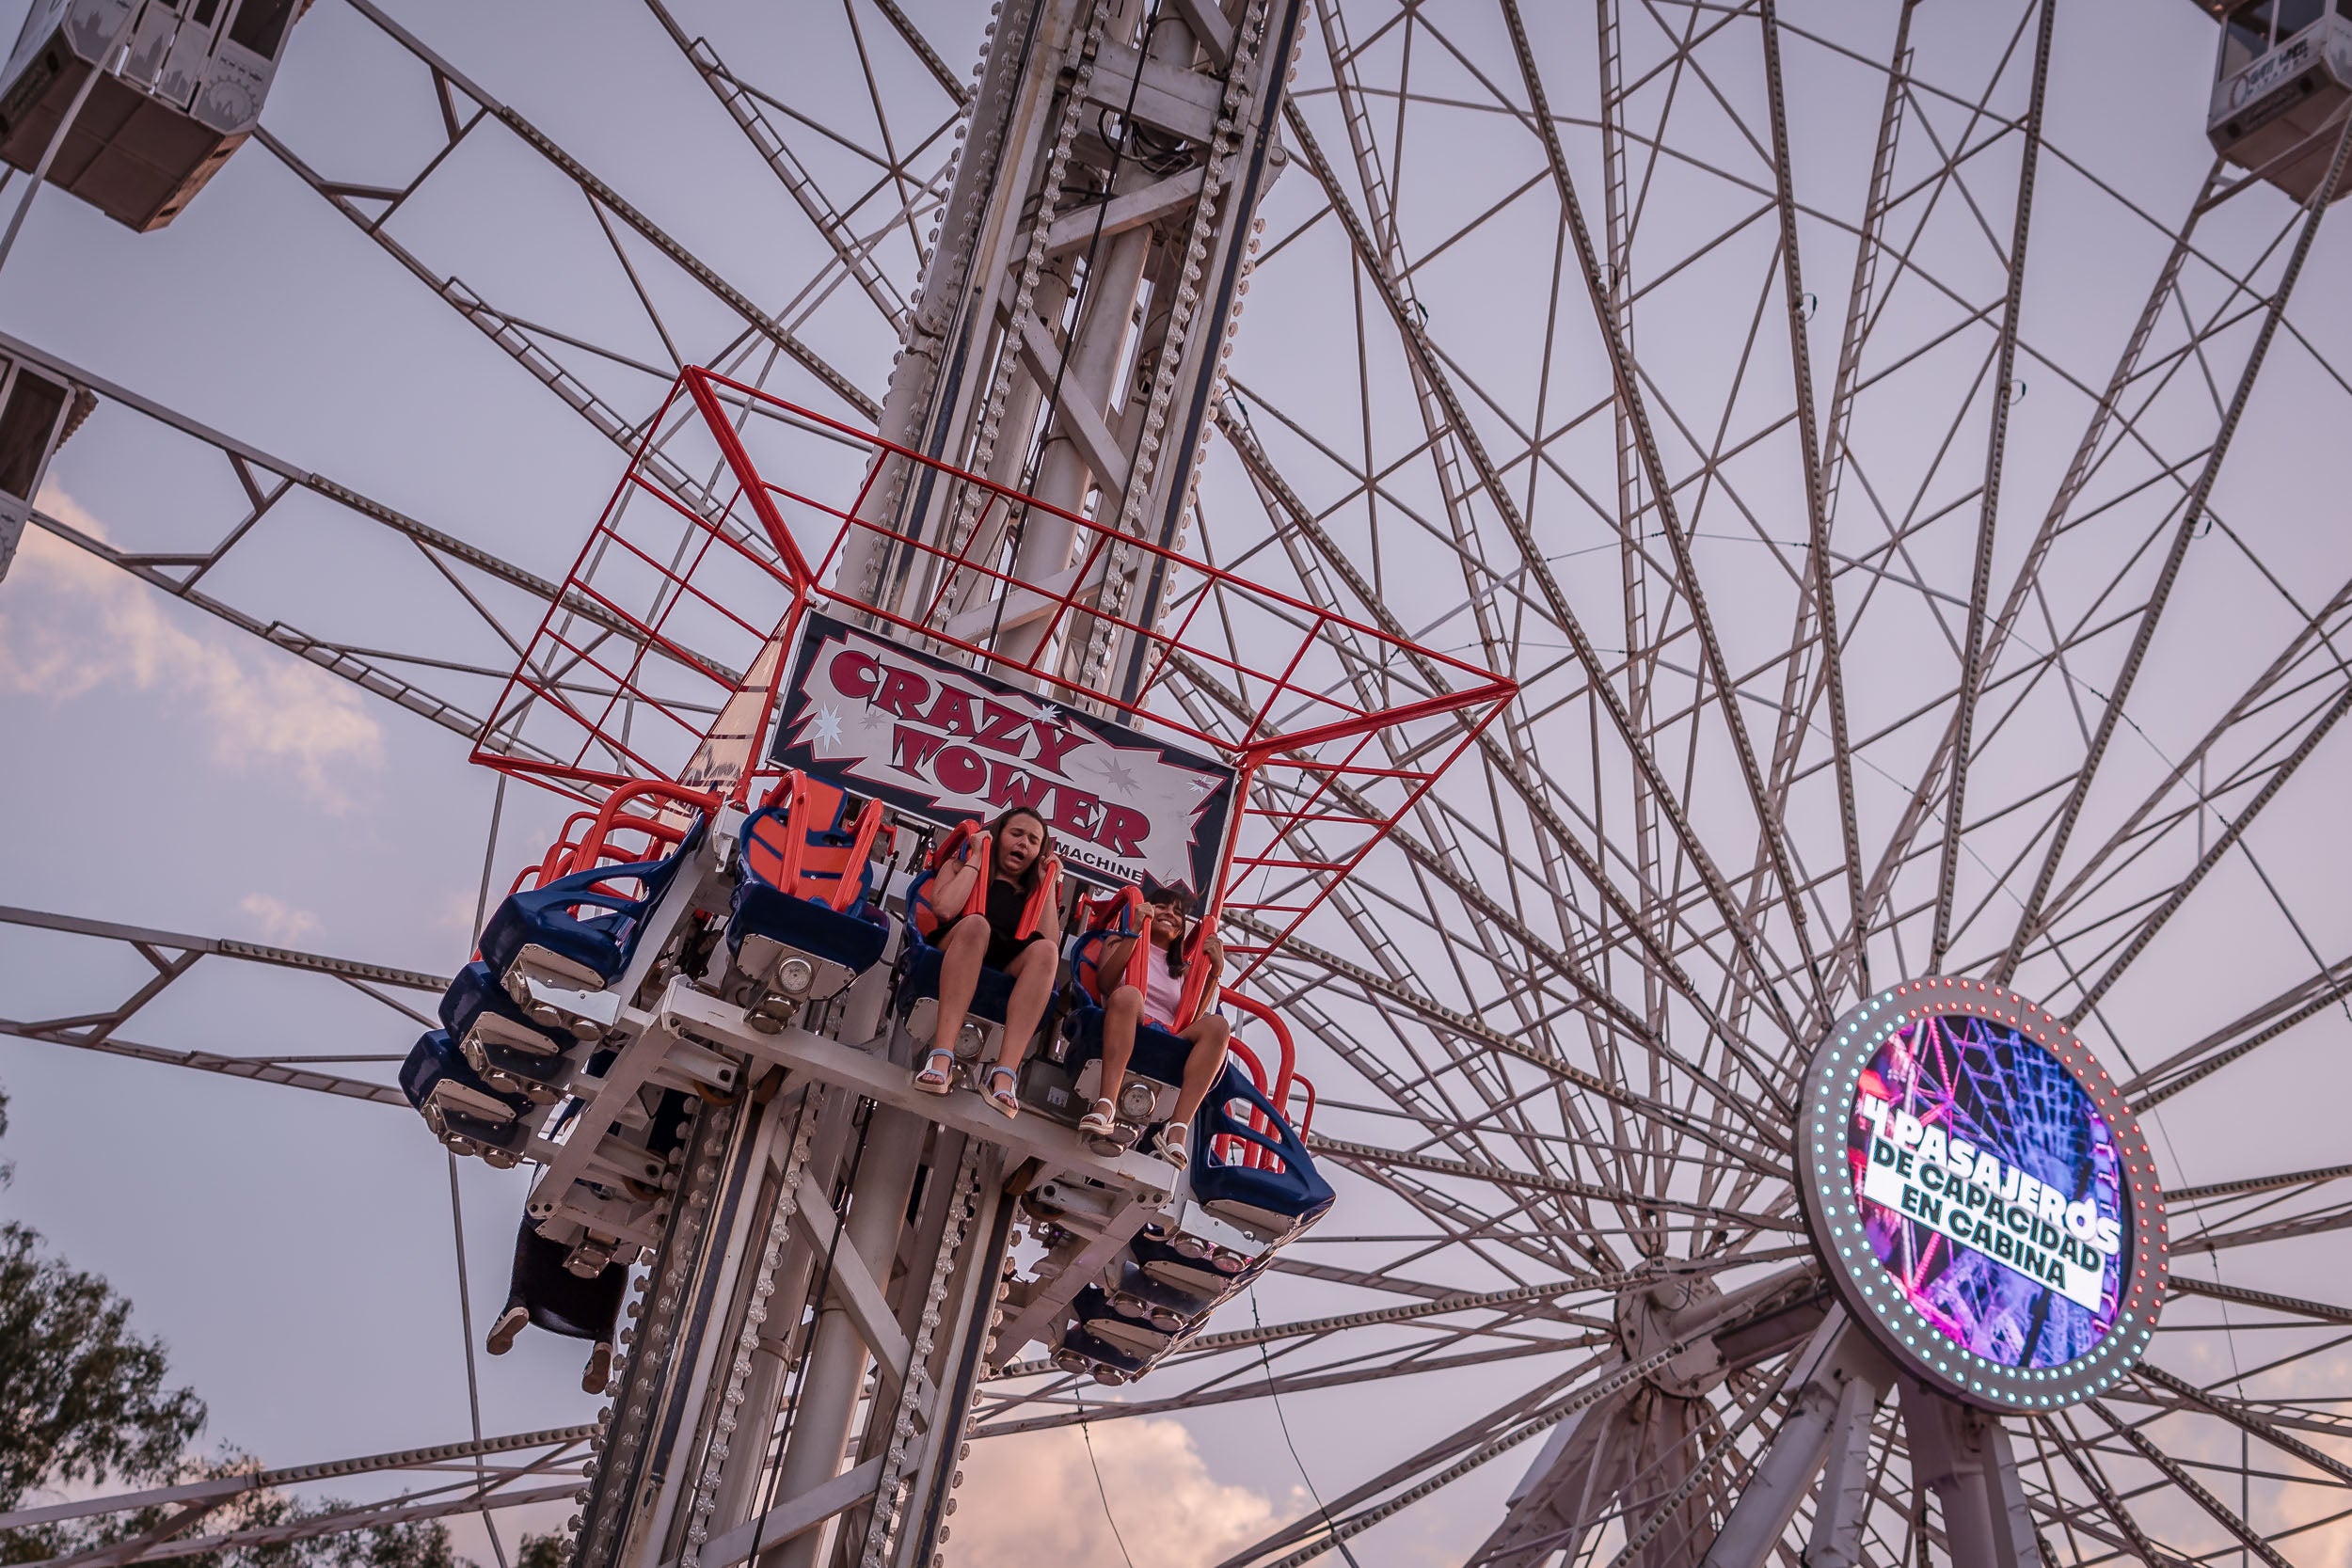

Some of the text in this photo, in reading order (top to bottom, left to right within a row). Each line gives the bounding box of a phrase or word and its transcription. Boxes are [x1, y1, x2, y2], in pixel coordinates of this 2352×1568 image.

[829, 650, 1095, 781] CRAZY
[886, 723, 1151, 860] TOWER
[1054, 840, 1144, 883] MACHINE
[1863, 1093, 1889, 1139] 4
[1873, 1138, 2101, 1272] DE CAPACIDAD
[1901, 1184, 2066, 1290] EN CABINA
